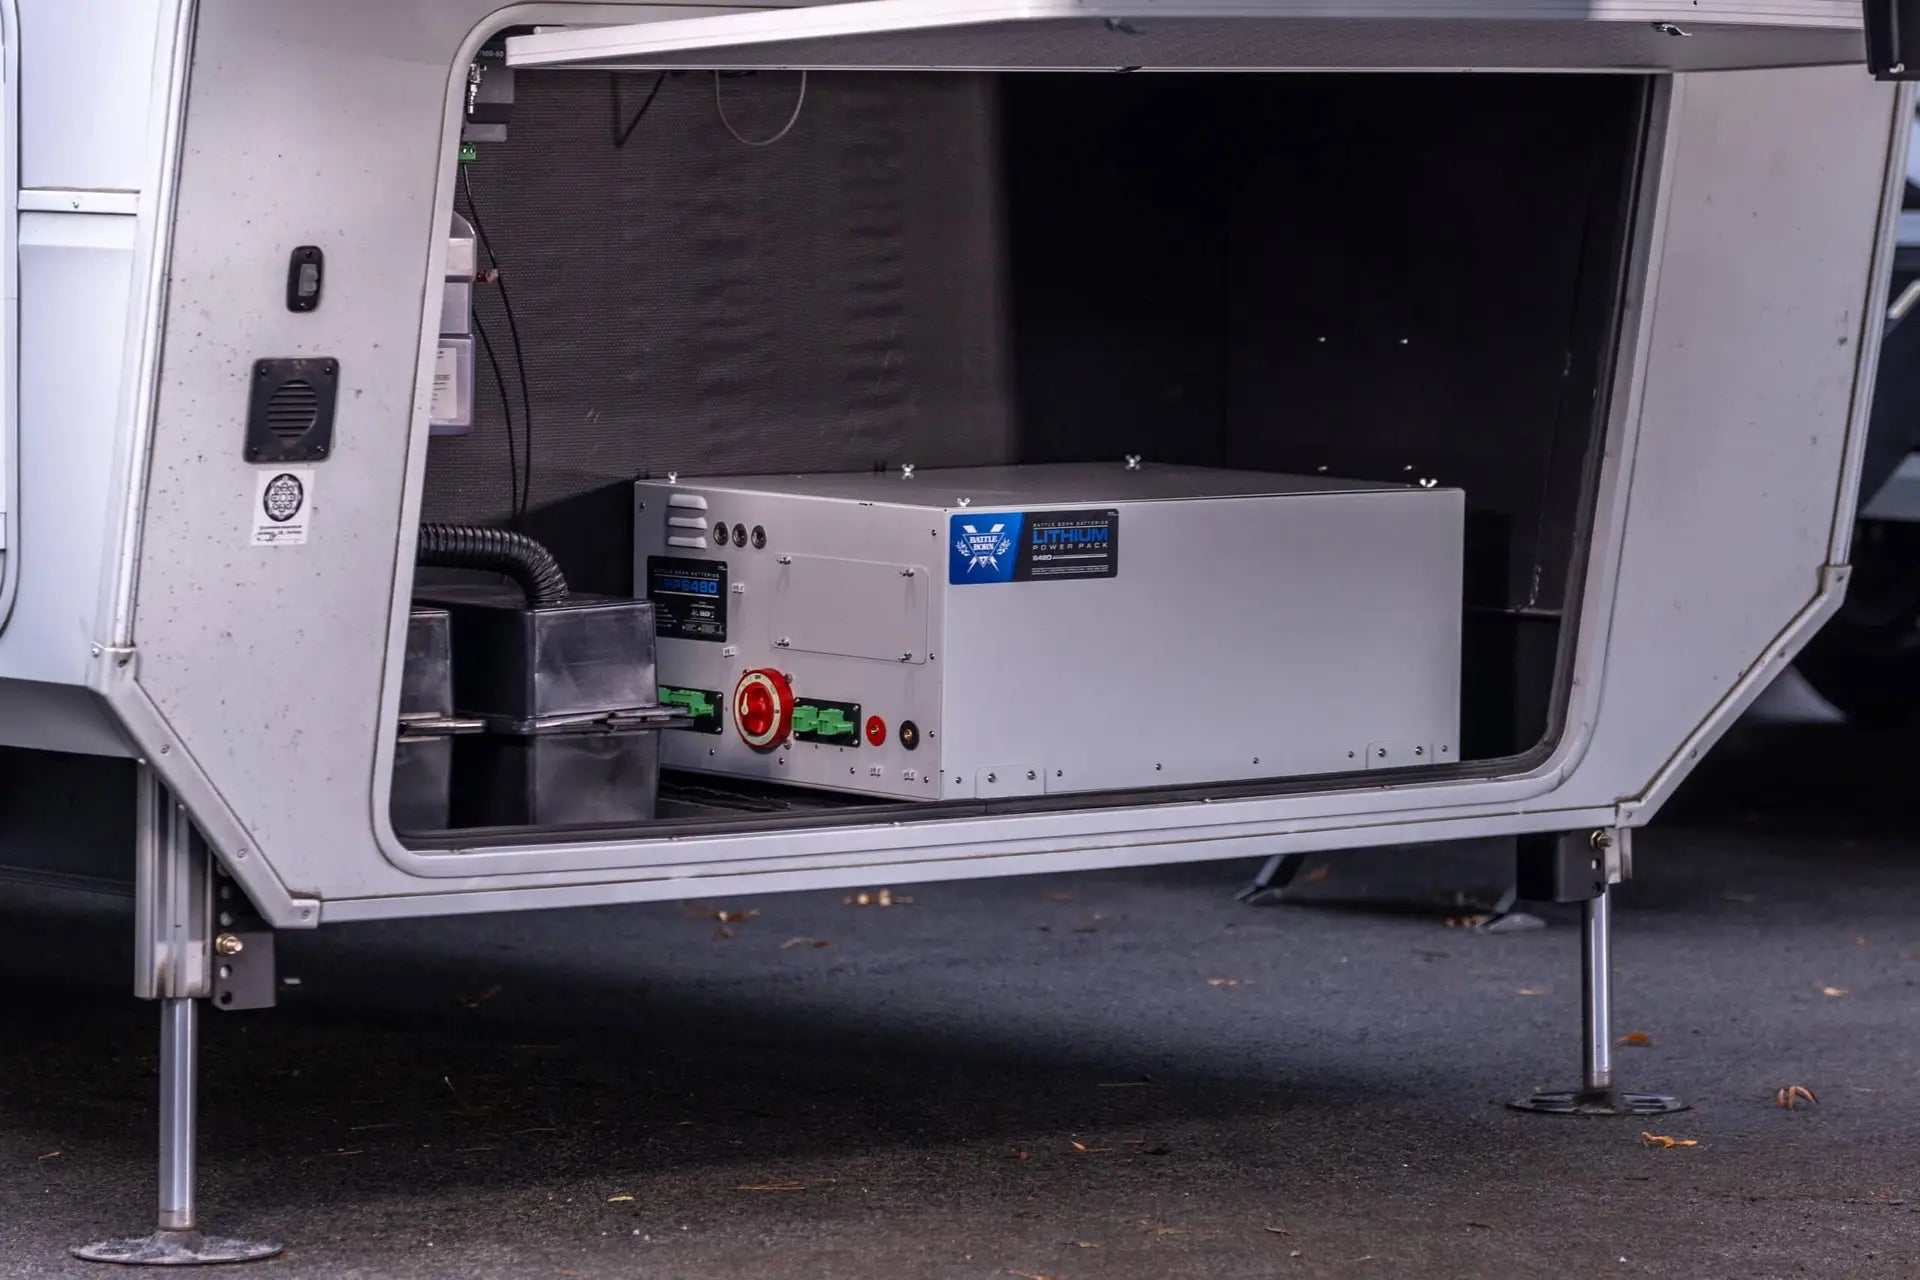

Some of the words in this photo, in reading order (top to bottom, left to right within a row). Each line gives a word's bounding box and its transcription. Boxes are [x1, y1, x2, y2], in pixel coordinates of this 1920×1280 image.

[969, 535, 998, 544] BATTLE
[1032, 527, 1109, 544] LITHIUM
[973, 543, 994, 551] BORN
[1032, 542, 1073, 551] POWER
[1078, 541, 1109, 550] PACK
